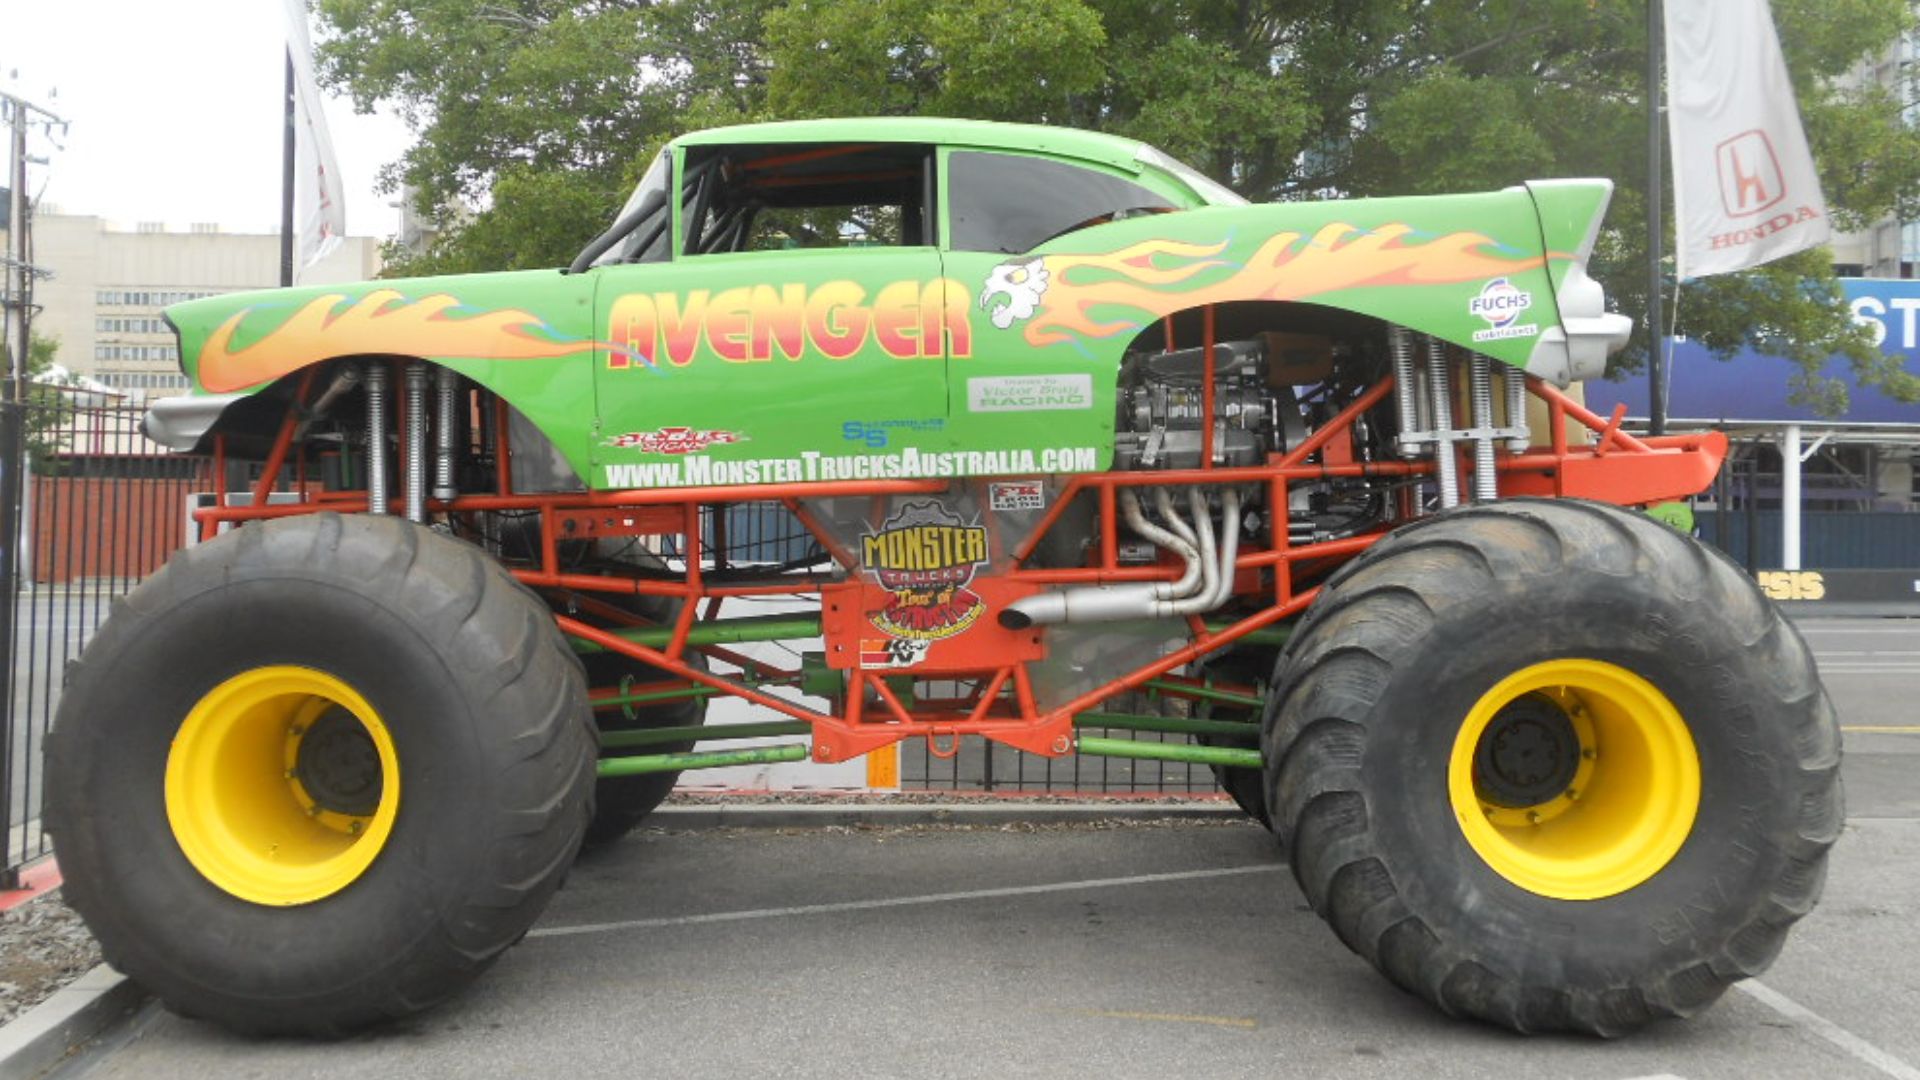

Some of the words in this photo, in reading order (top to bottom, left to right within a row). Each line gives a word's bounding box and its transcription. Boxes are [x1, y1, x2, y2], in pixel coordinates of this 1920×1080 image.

[1711, 205, 1819, 251] HONDA
[1471, 293, 1529, 312] FUCHS
[606, 277, 973, 369] AVENGER
[978, 394, 1085, 407] RACING
[863, 526, 987, 570] MONSTER
[887, 569, 965, 582] TRUCKS
